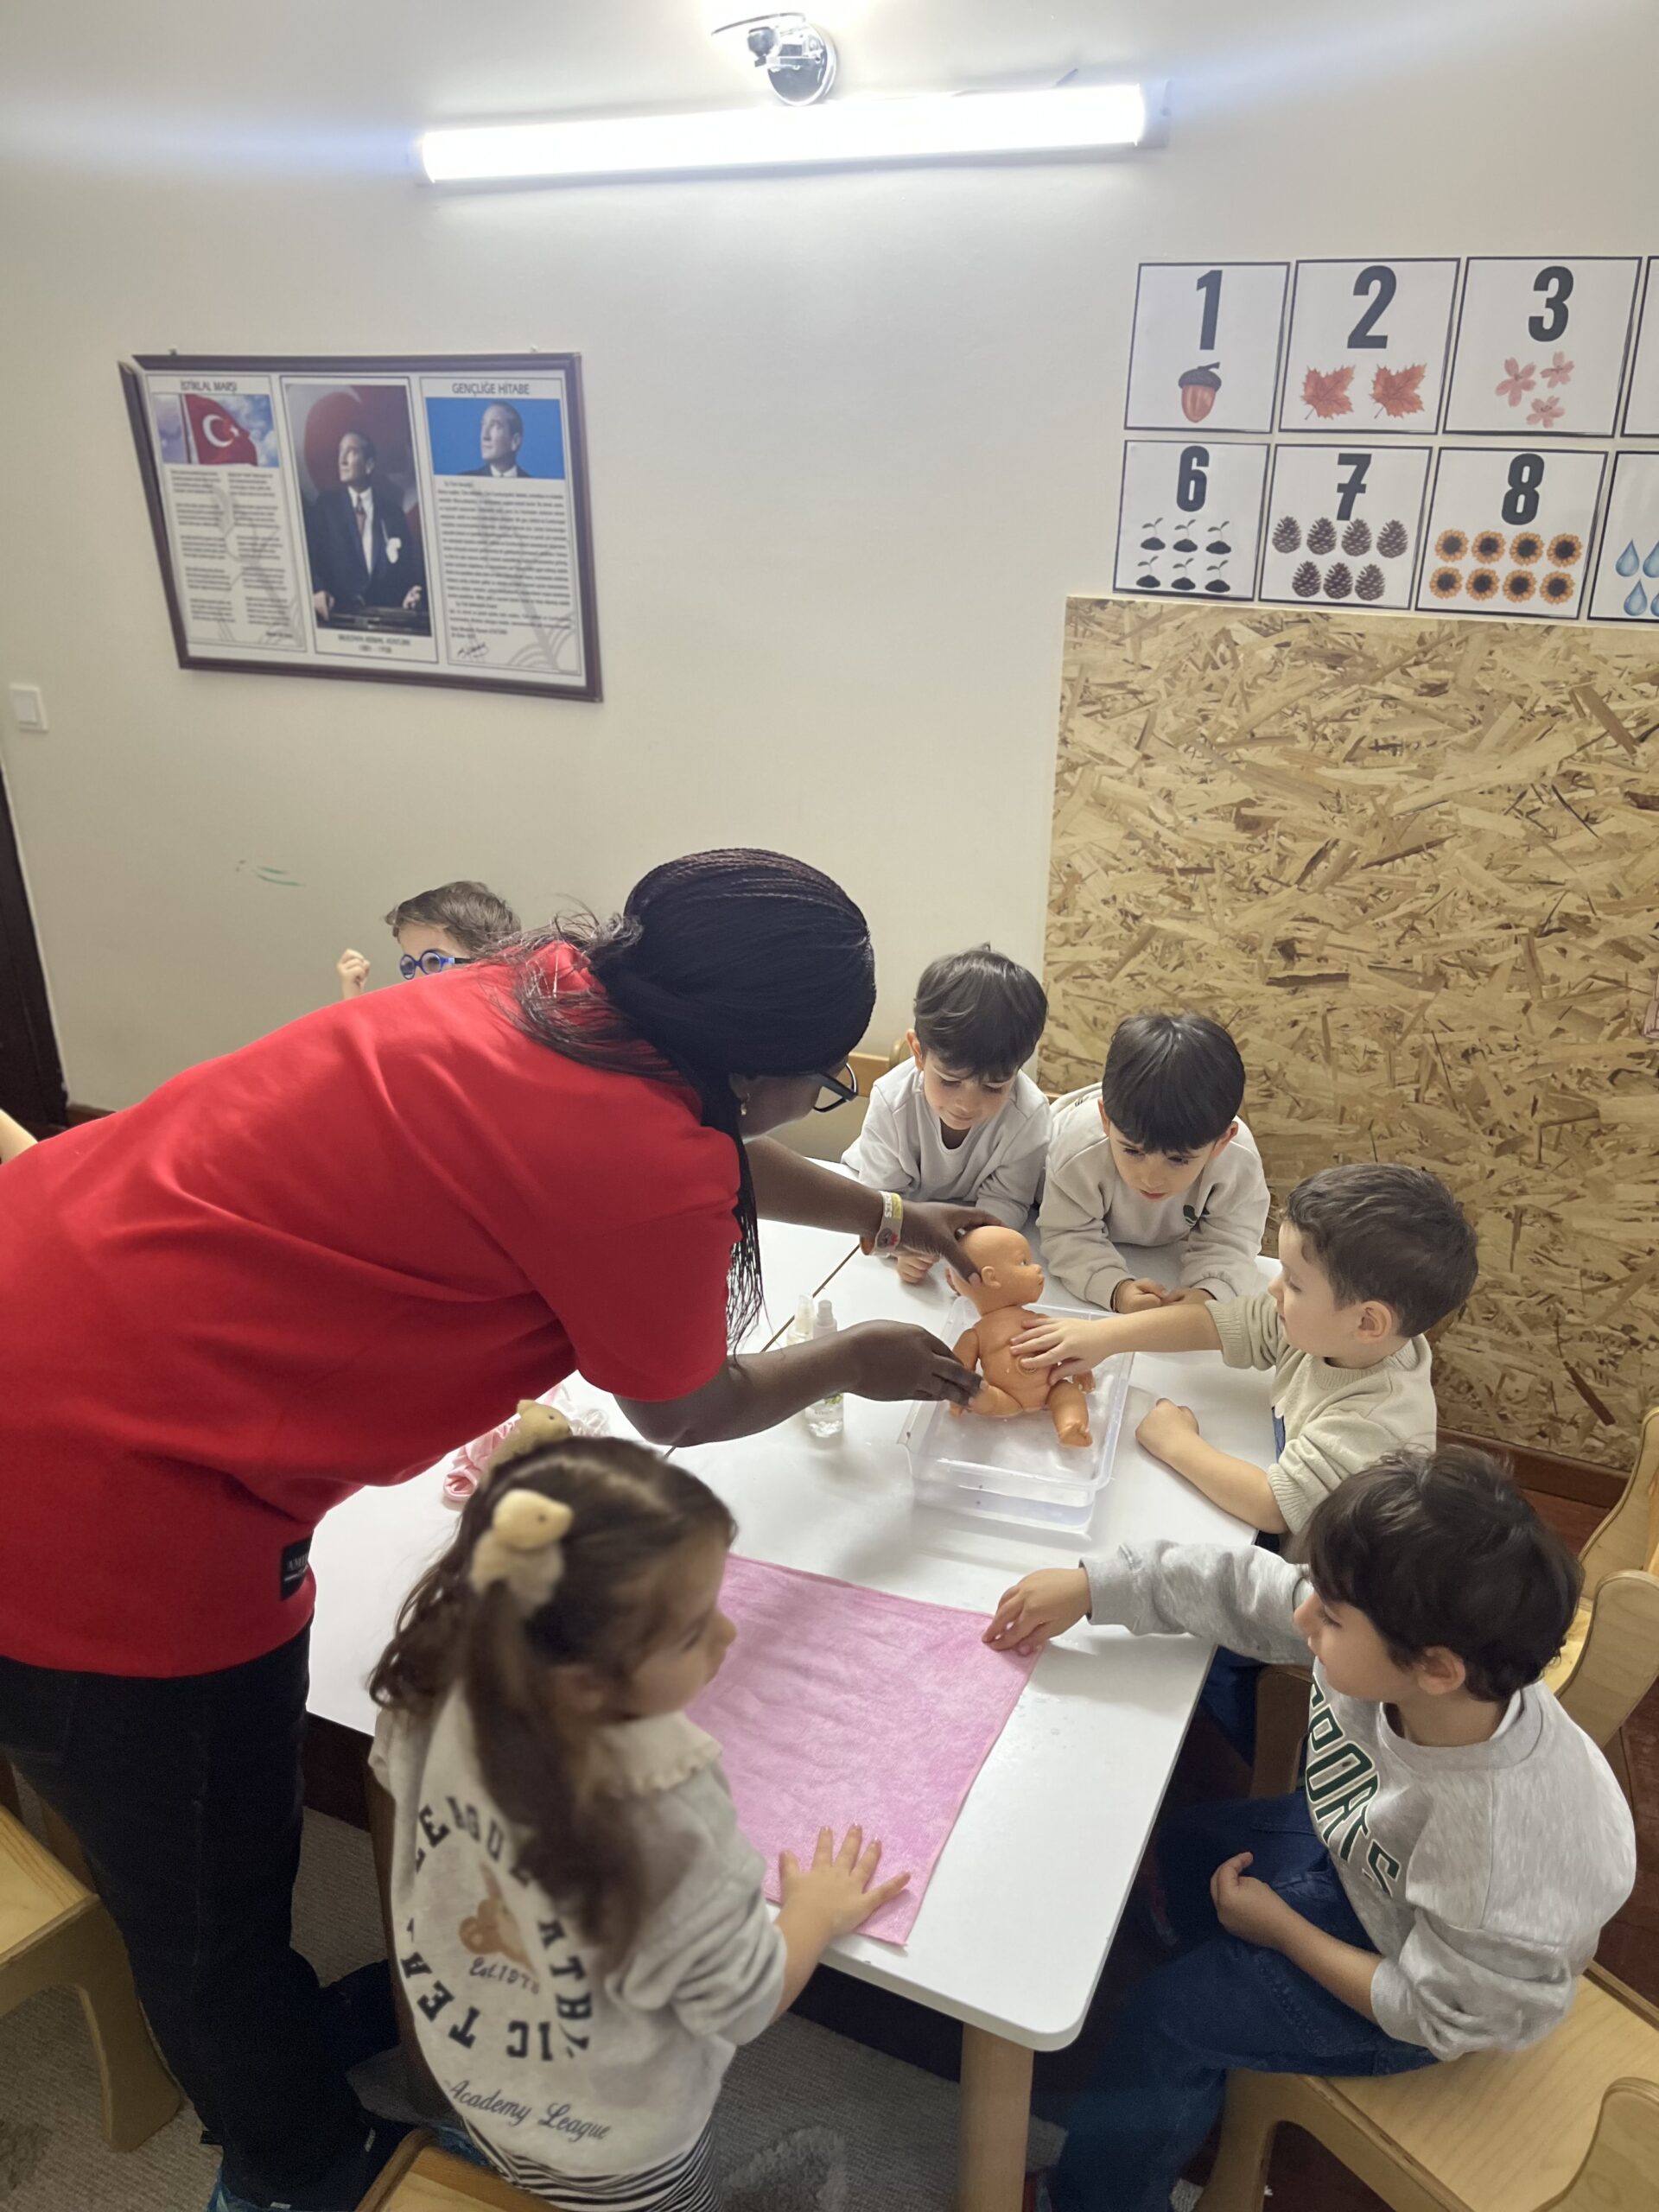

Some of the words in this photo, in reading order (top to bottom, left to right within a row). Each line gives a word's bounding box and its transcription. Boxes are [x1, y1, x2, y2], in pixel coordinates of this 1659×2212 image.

[1196, 270, 1223, 350] 1
[1347, 265, 1397, 349] 2
[1528, 265, 1574, 342] 3
[1176, 446, 1210, 512] 6
[1336, 453, 1372, 521] 7
[1501, 453, 1545, 525] 8
[444, 2079, 532, 2126] Academy
[537, 2102, 611, 2143] League
